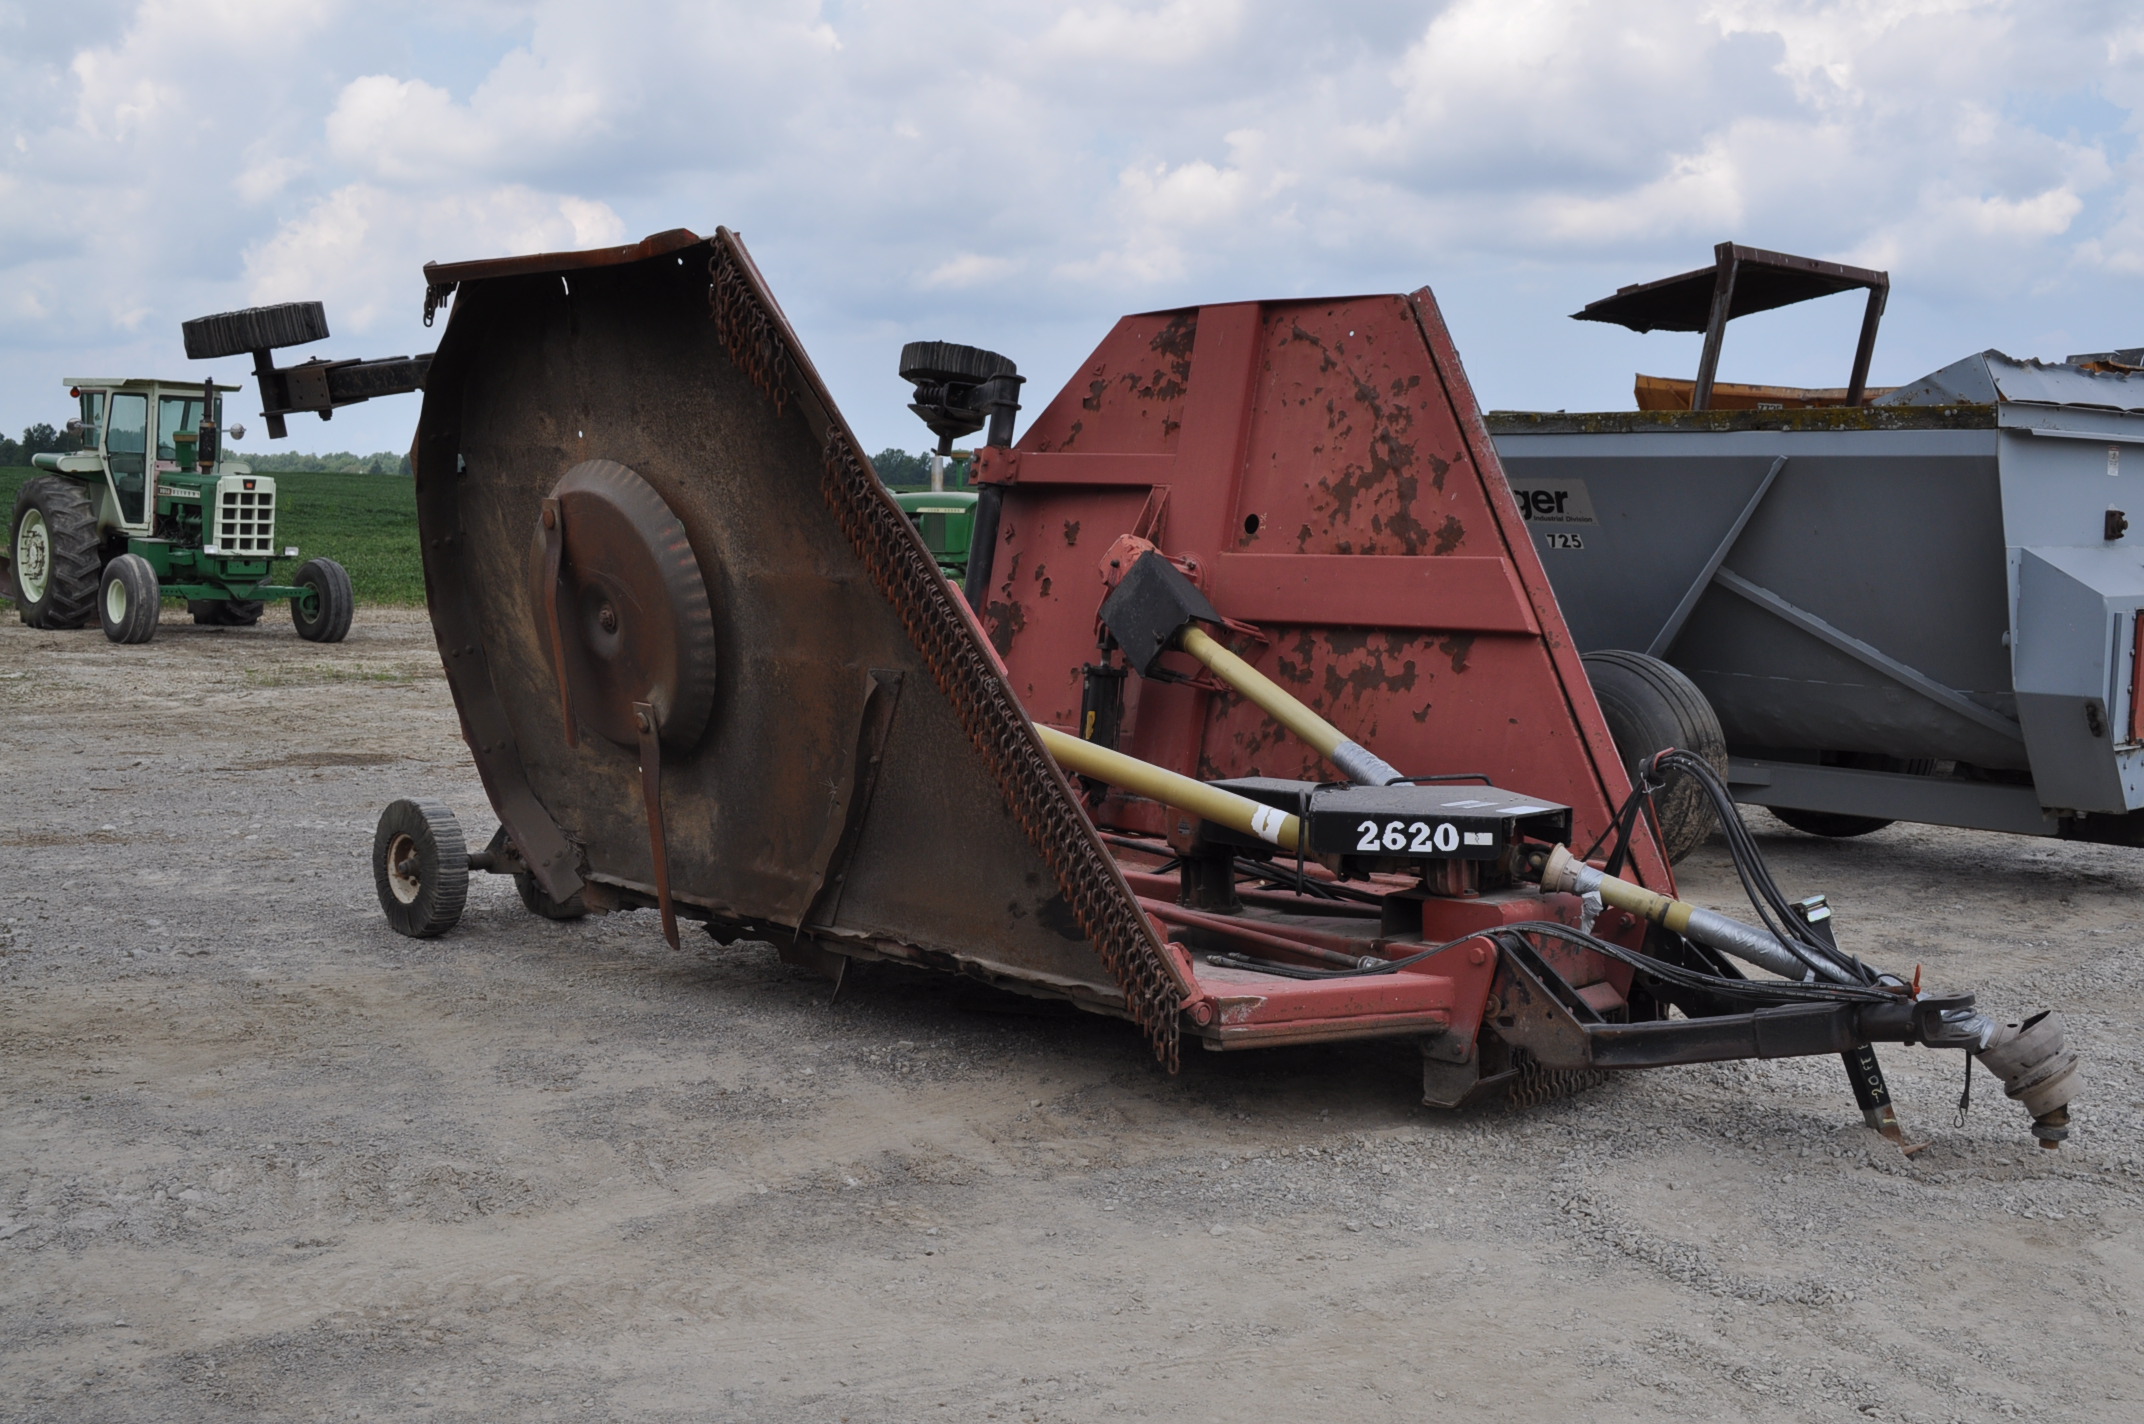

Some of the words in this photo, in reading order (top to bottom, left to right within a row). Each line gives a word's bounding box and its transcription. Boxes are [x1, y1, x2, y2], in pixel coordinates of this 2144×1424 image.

[1566, 515, 1593, 523] Division
[1547, 534, 1582, 548] 725
[1357, 820, 1459, 852] 2620
